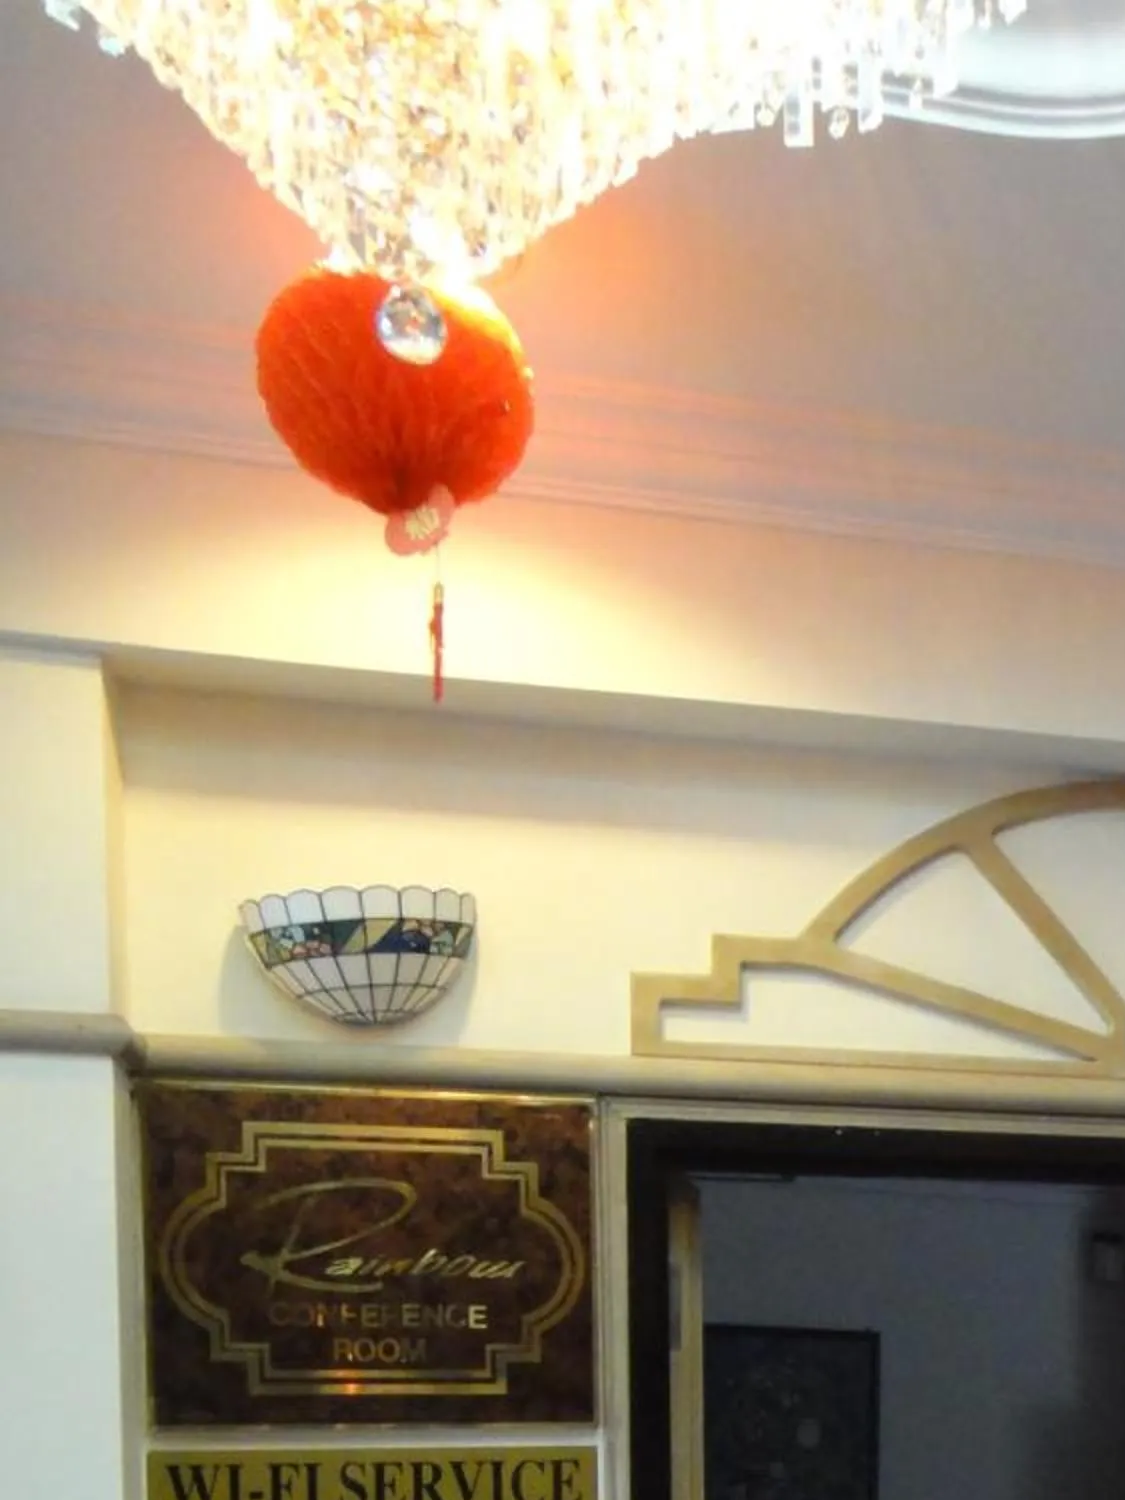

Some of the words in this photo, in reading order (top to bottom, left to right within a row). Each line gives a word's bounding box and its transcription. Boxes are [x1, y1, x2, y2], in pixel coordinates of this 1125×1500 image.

[240, 1177, 526, 1298] Rainbow
[268, 1301, 489, 1330] CONFERENCE
[333, 1337, 427, 1363] ROOM
